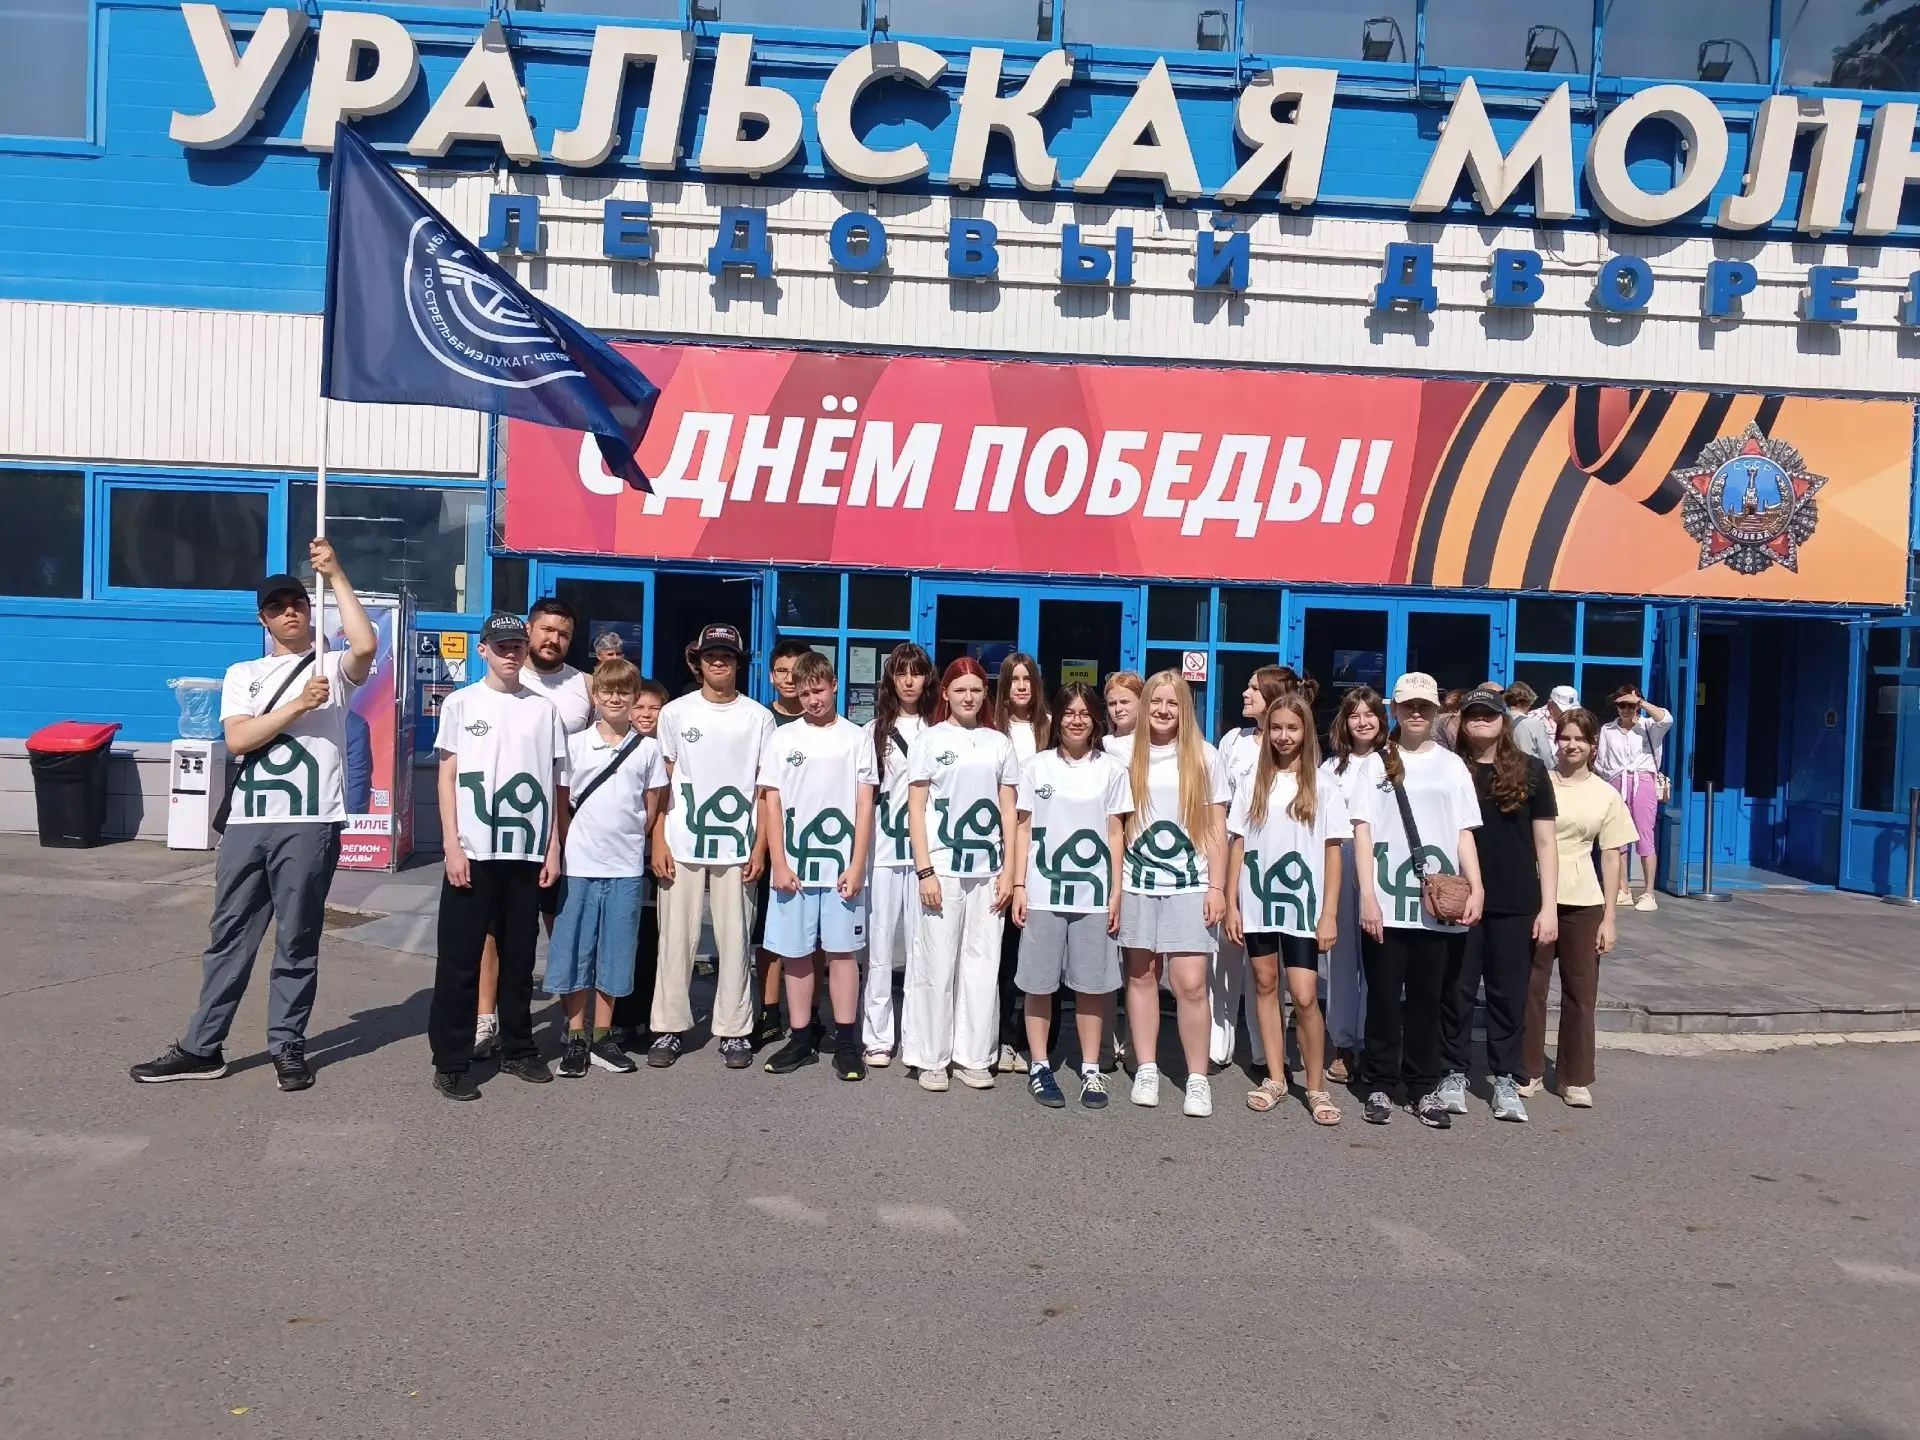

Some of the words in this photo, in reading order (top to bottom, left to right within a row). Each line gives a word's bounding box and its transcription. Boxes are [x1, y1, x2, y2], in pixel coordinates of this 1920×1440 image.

[169, 3, 1339, 206] УРАЛЬСКАЯ
[478, 192, 1250, 291] ЛЕДОВЫЙ
[1375, 241, 1920, 327] ДВОРЕ
[463, 346, 484, 361] ИЗ
[483, 354, 521, 368] ЛУКА
[641, 394, 943, 518] ДНЁМ
[954, 425, 1394, 538] ПОБЕДЫ!
[1731, 530, 1770, 541] ПОБЕДА
[338, 854, 374, 863] РЖАВЫ
[342, 844, 380, 853] РЕГИОН
